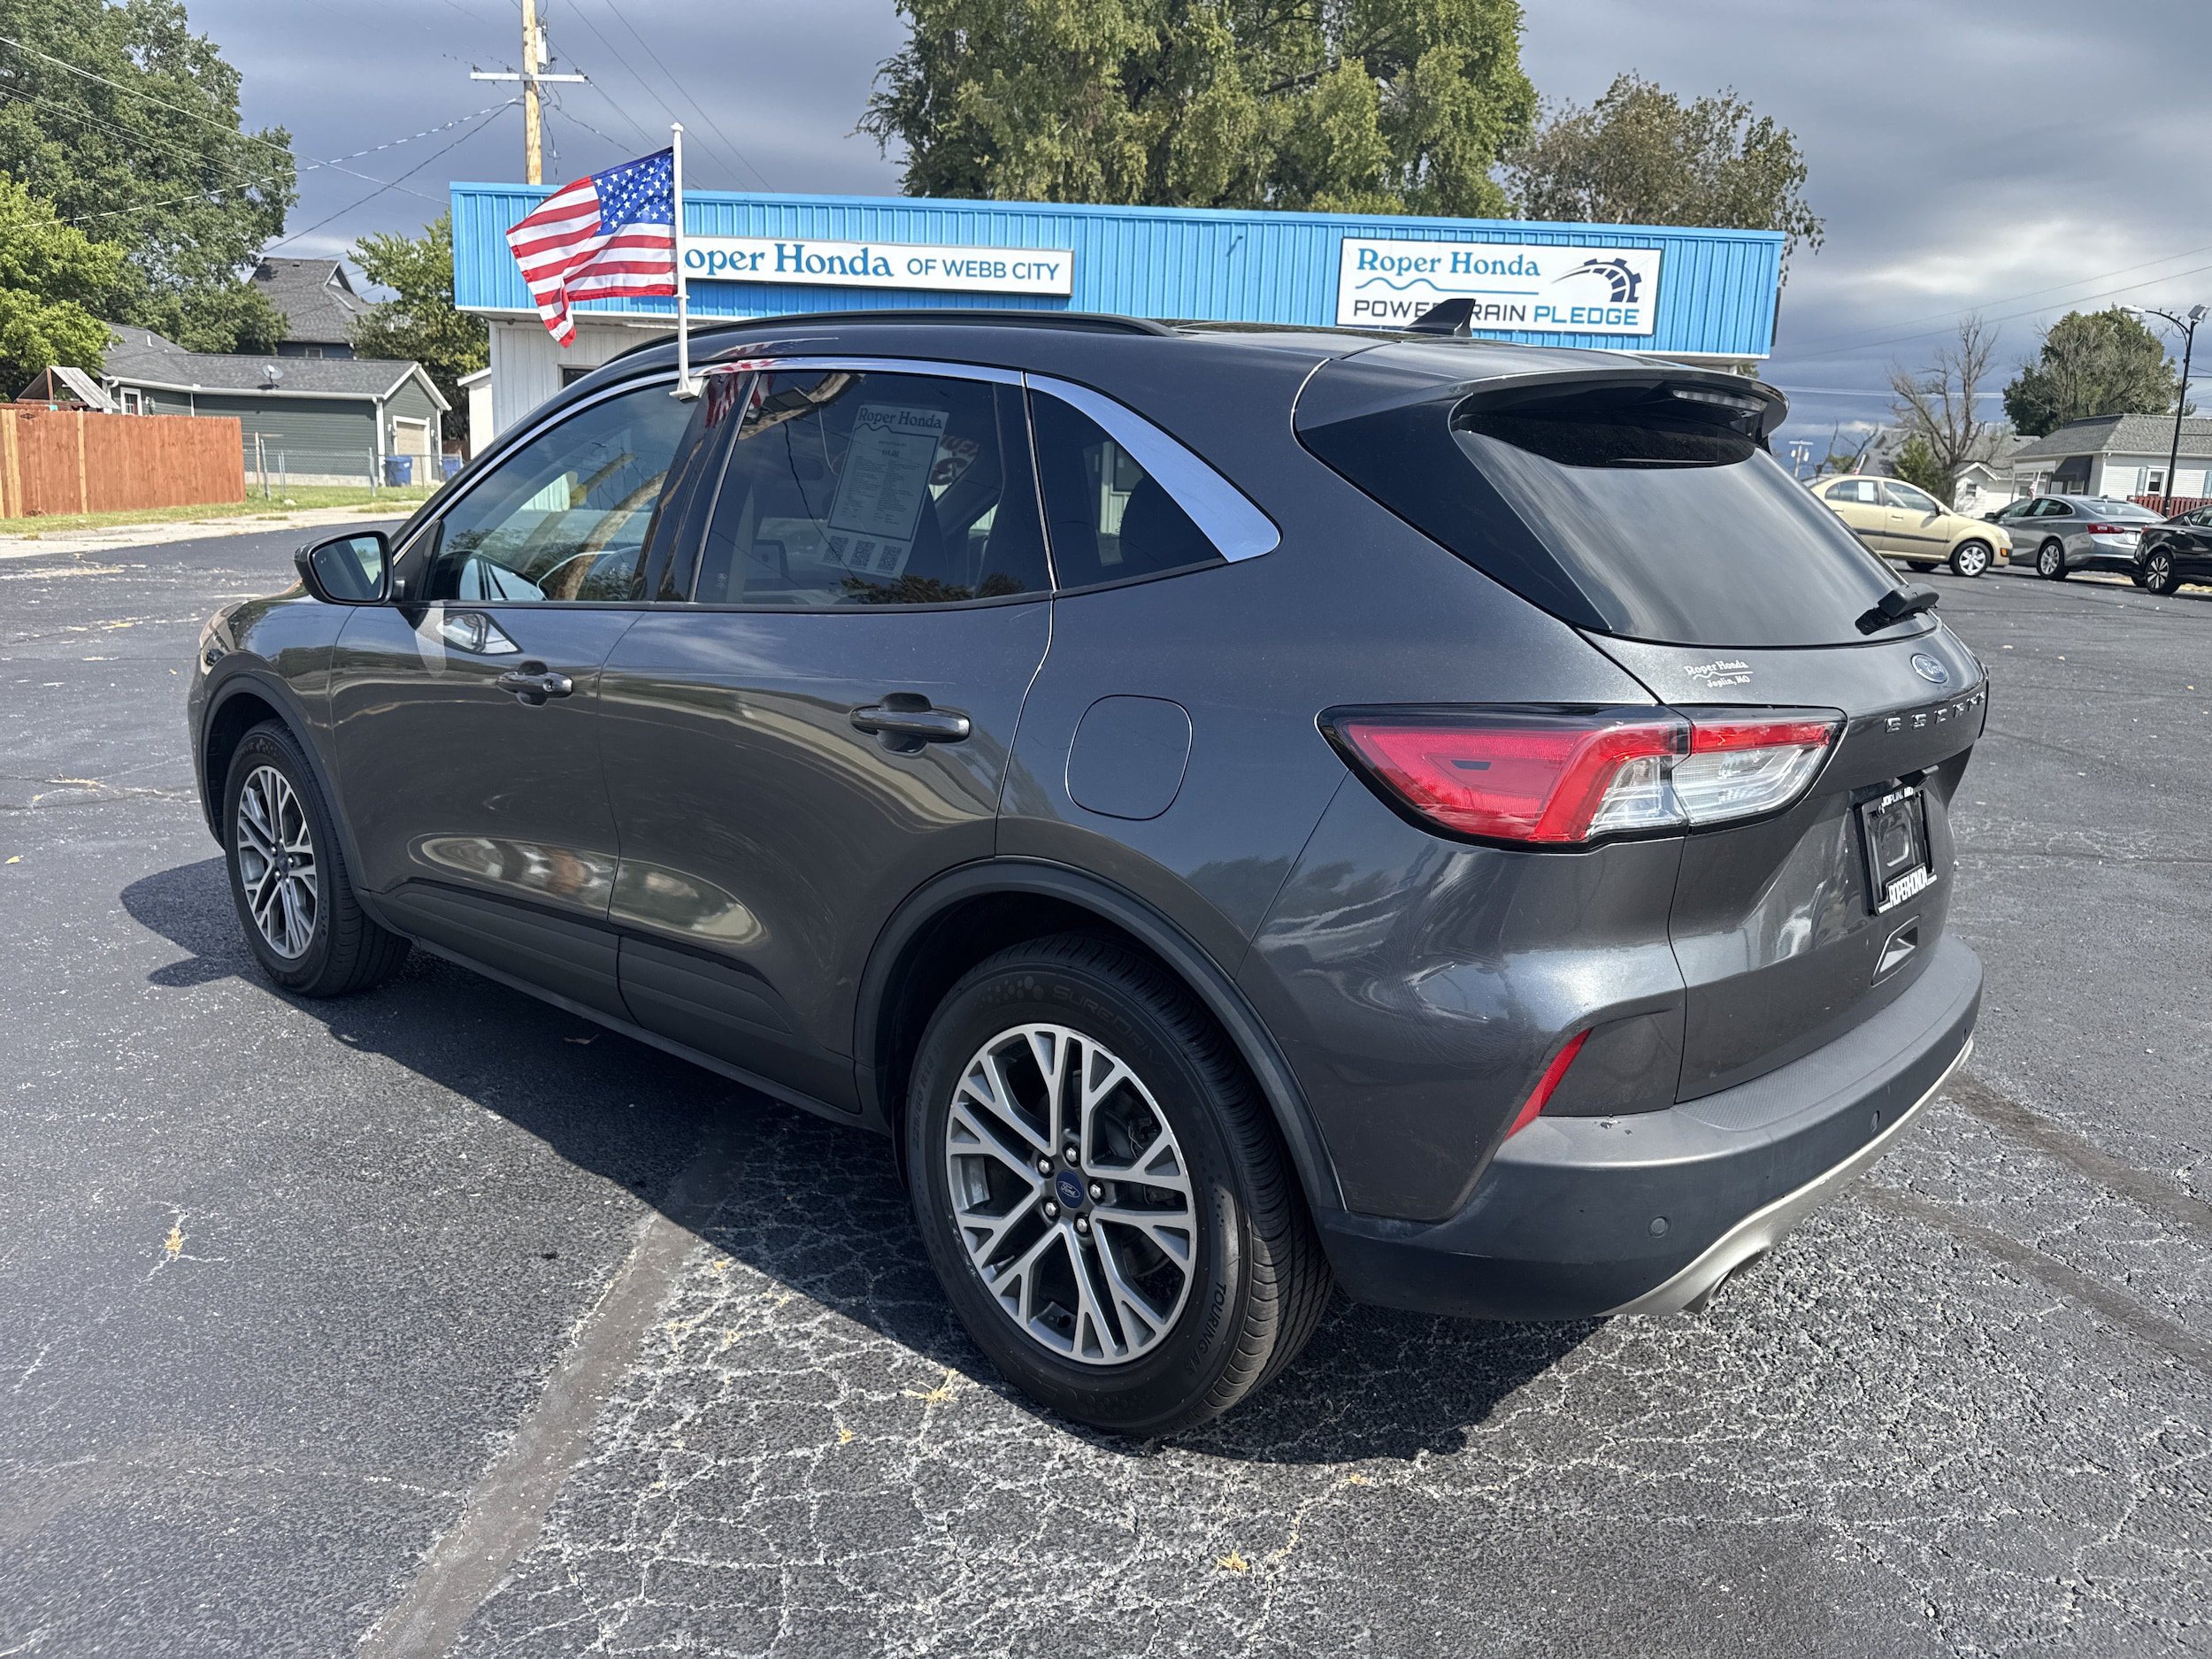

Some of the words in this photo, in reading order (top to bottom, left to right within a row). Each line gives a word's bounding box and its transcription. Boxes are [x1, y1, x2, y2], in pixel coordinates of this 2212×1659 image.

[684, 249, 765, 275] oper
[773, 243, 895, 278] Honda
[907, 258, 939, 276] OF
[943, 259, 1007, 279] WEBB
[1011, 262, 1060, 281] CITY
[1356, 248, 1441, 276] Roper
[1450, 251, 1540, 276] Honda
[1354, 299, 1526, 322] POWERAIN
[1533, 305, 1640, 326] PLEDGE
[858, 408, 896, 425] Roper
[898, 411, 942, 429] Honda
[1684, 664, 1717, 675] Roper
[1715, 659, 1749, 671] Honda
[1735, 675, 1750, 684] MO
[1199, 1281, 1227, 1355] TOURING
